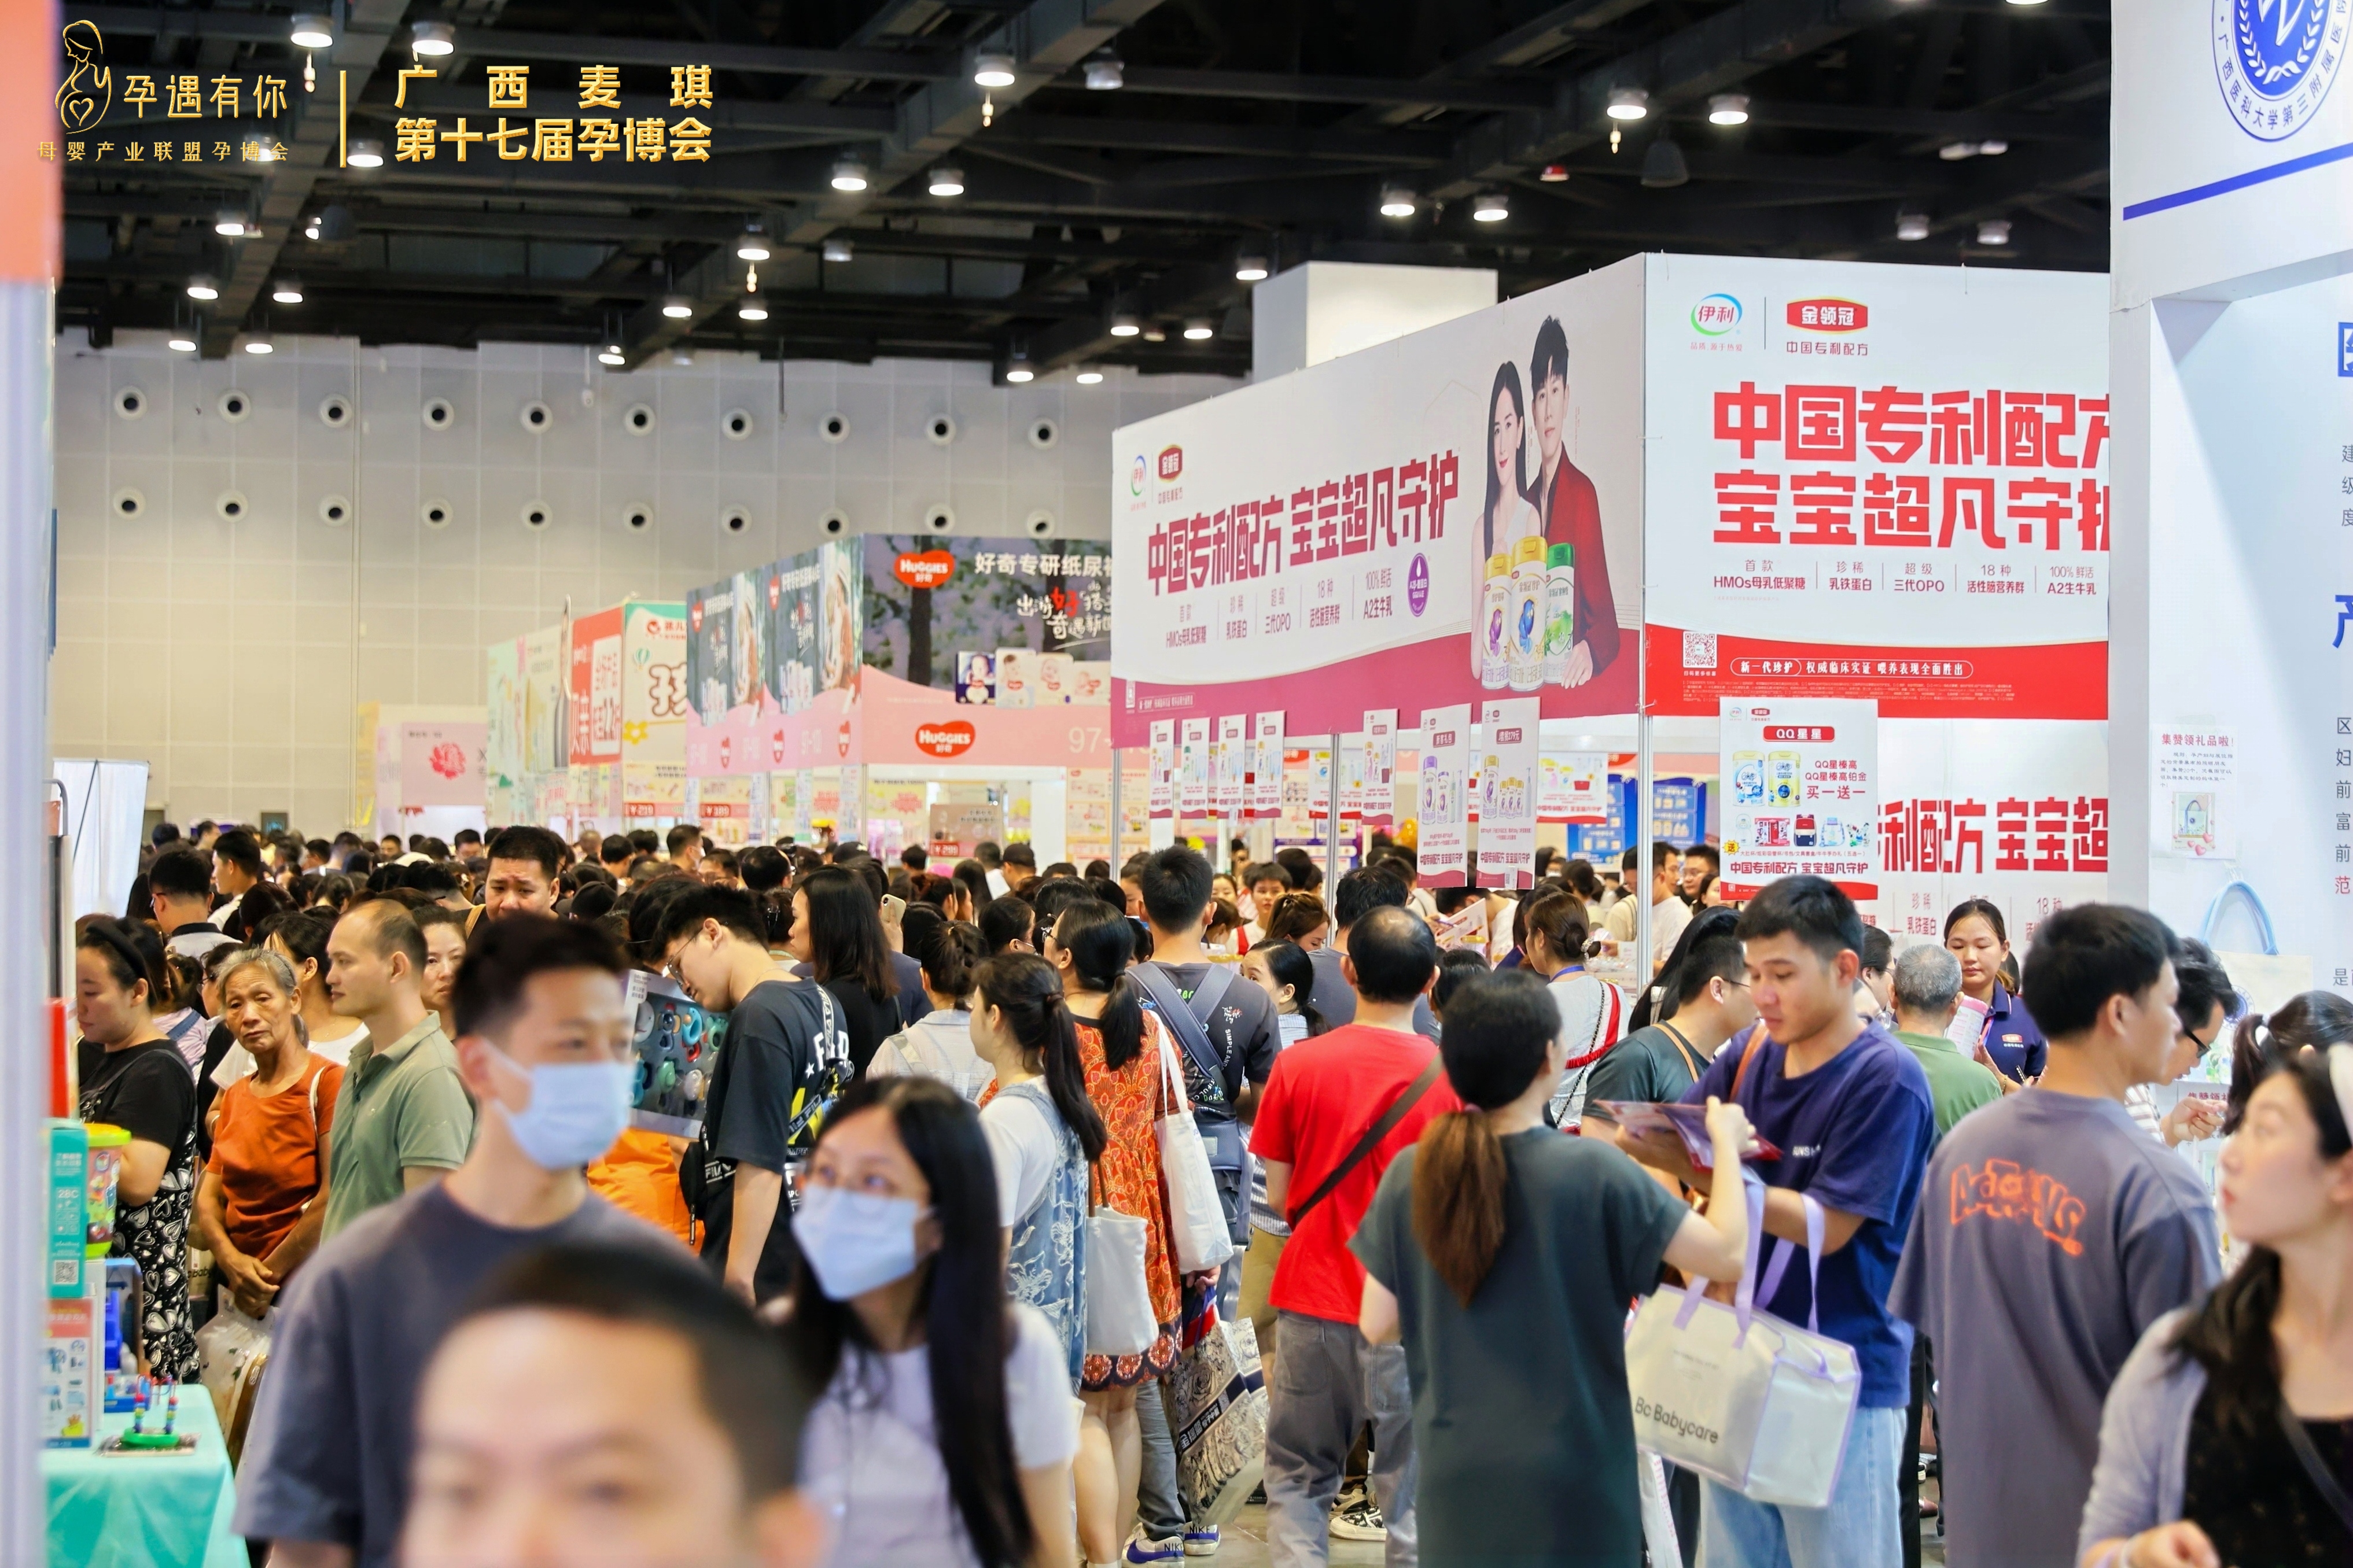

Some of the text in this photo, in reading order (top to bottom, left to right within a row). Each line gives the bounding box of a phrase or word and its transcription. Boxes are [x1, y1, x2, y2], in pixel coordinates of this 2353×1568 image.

[1698, 305, 1735, 323] 伊利
[1801, 305, 1854, 326] 金领冠
[1787, 341, 1868, 356] 中国专利配方
[1148, 449, 1459, 596] 中国专利配方 宝宝超凡守护
[1745, 559, 1773, 572] 首款
[1836, 561, 1864, 574] 珍稀
[1905, 562, 1932, 575] 超级
[1981, 565, 2012, 577] 18 种
[2050, 566, 2094, 579] 100% 鲜活
[1714, 576, 1806, 590] HMOs母乳低聚糖
[1829, 578, 1872, 591] 乳铁蛋白
[1894, 580, 1945, 592] 三代OPO
[1967, 581, 2024, 594] 活性脑营养群
[2048, 582, 2097, 596] A2生牛乳
[1364, 595, 1393, 619] A2生牛乳
[1740, 661, 1794, 674] 新一代珍护
[1806, 661, 1963, 676] 权威临床实证 喂养表现全面胜出
[1776, 728, 1822, 740] QQ星星
[1806, 785, 1865, 799] 买一送一
[1878, 799, 1986, 873] 利配方
[1730, 861, 1869, 875] 中国专利配方 宝宝超凡守护
[1907, 916, 1936, 936] 乳铁蛋白
[1635, 1396, 1718, 1444] Bc Babycare
